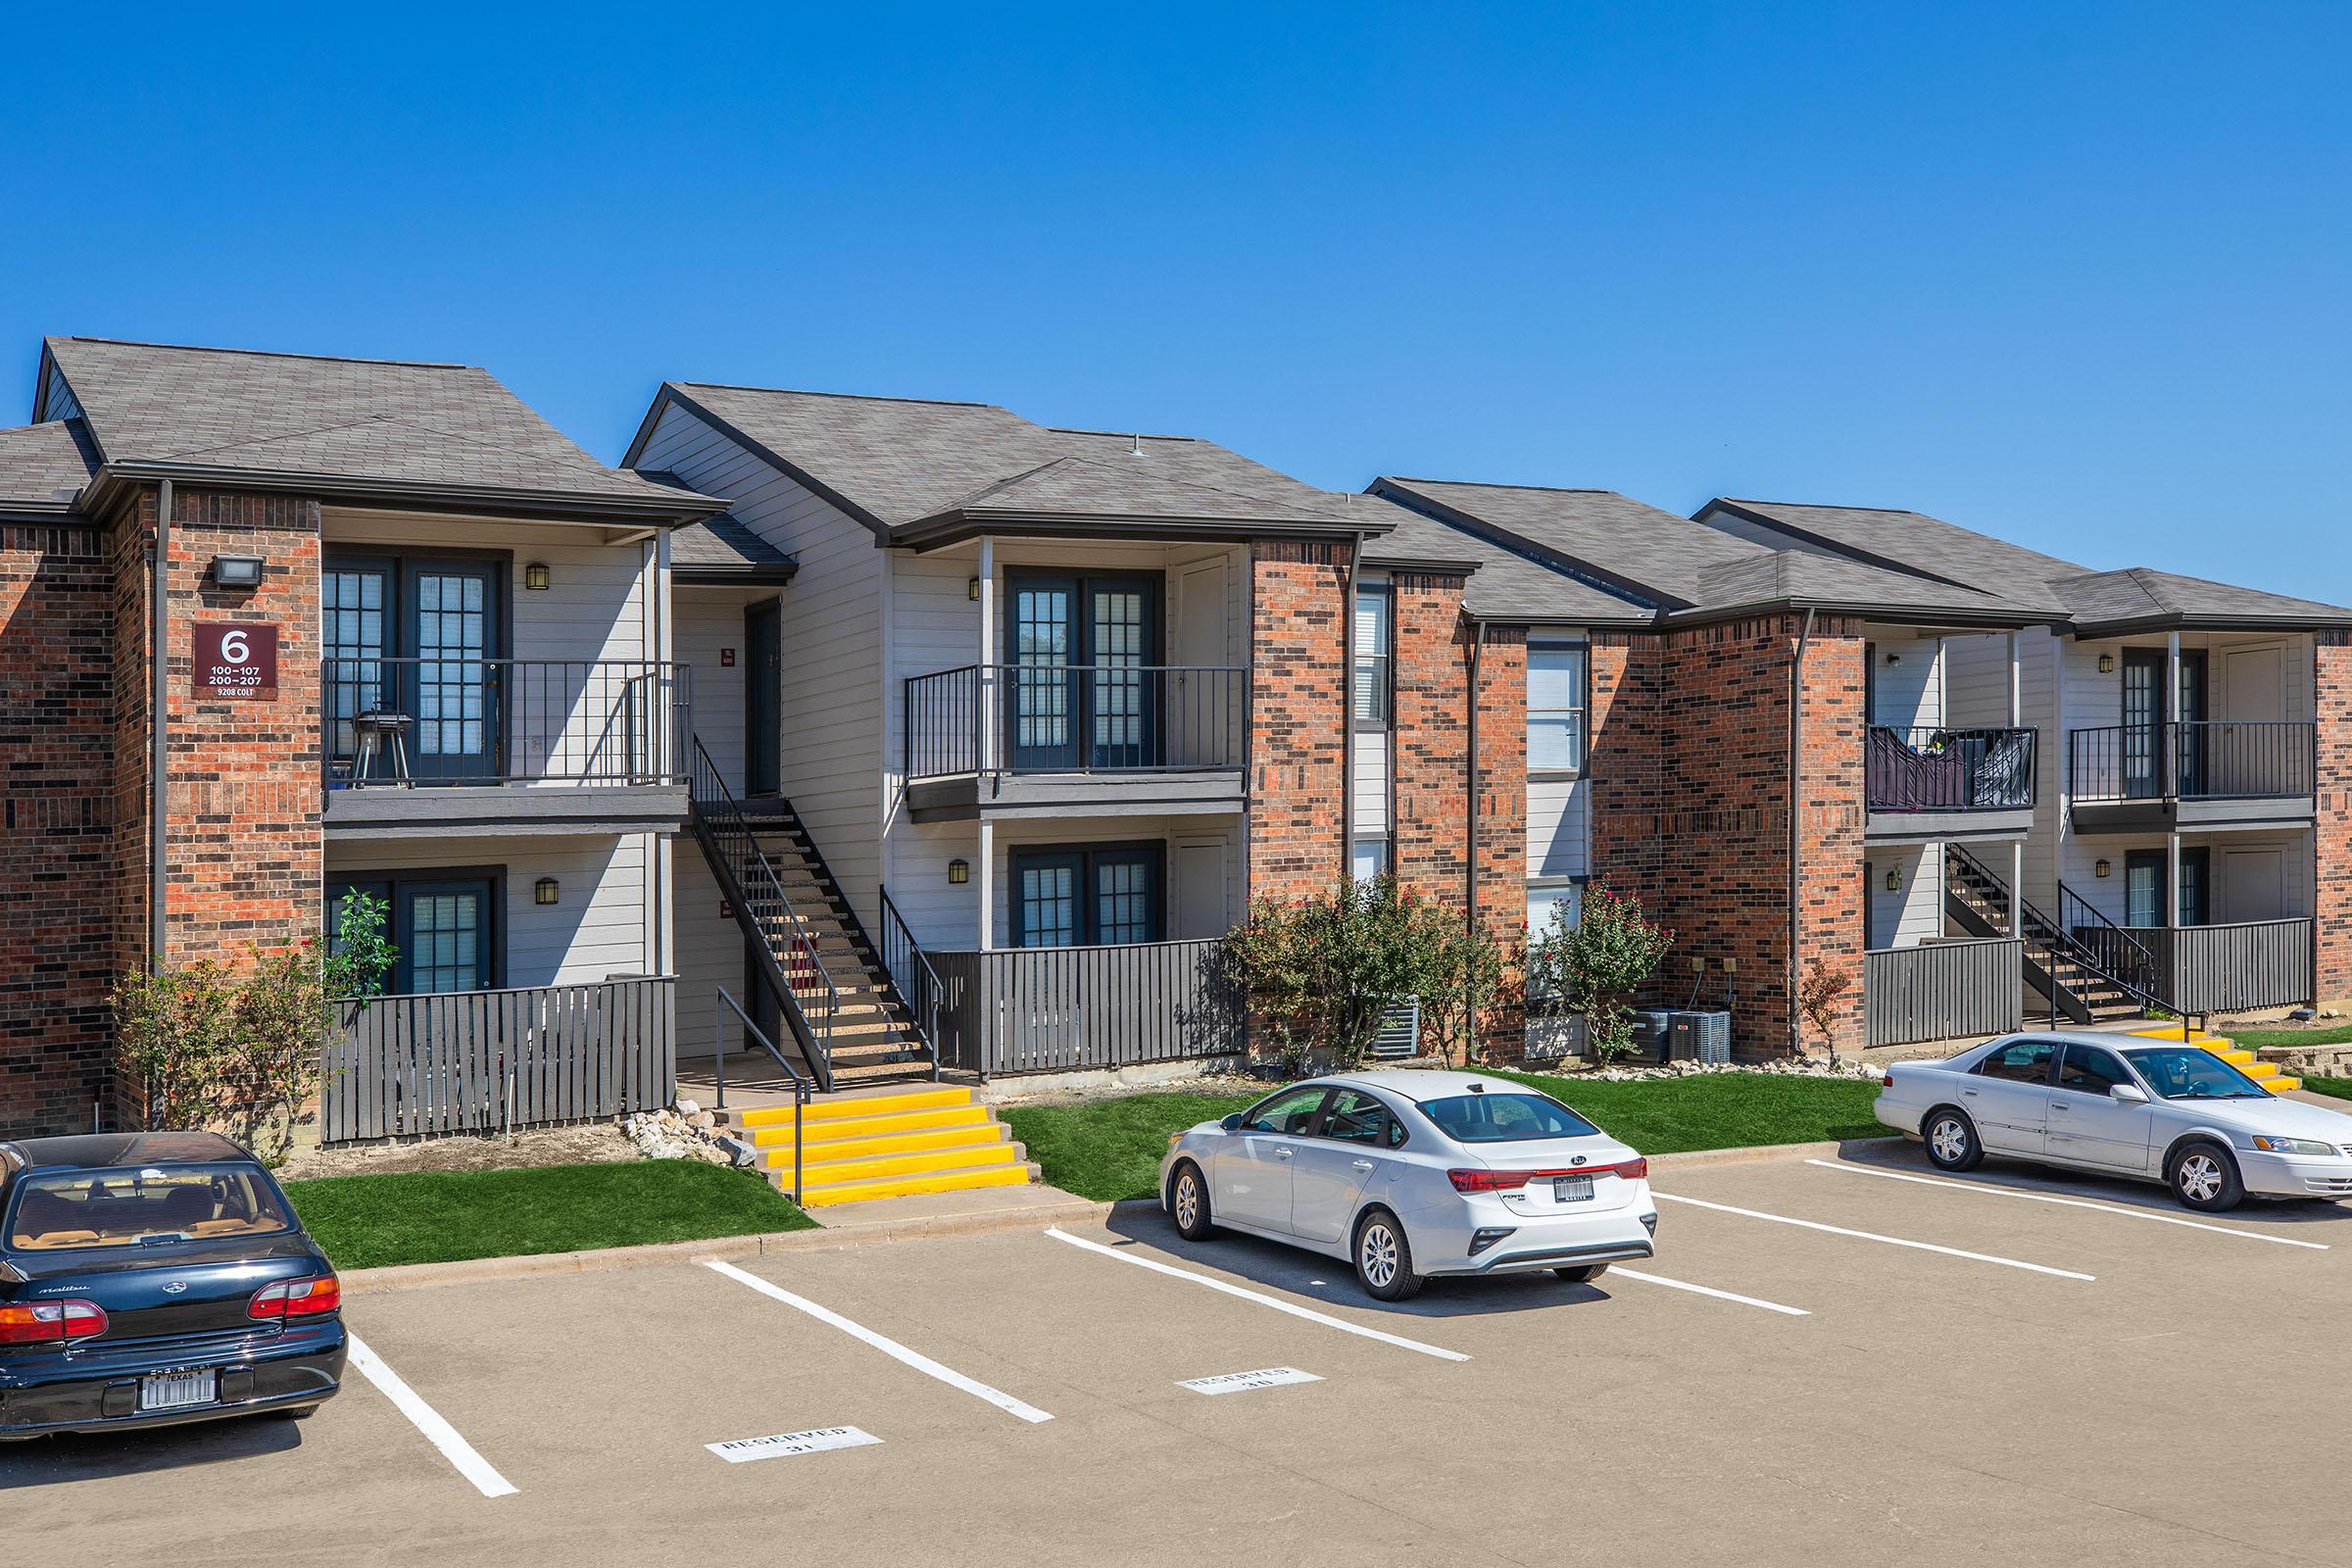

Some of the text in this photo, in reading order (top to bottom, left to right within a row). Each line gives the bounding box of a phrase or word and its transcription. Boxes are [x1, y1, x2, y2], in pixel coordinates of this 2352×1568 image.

[220, 630, 250, 663] 6
[211, 666, 260, 675] 100-107
[209, 676, 262, 685] 200-207
[218, 688, 254, 697] 9208 COLT
[167, 1373, 194, 1383] TEXAS
[721, 1427, 848, 1449] RESERVED
[786, 1444, 814, 1452] 31
